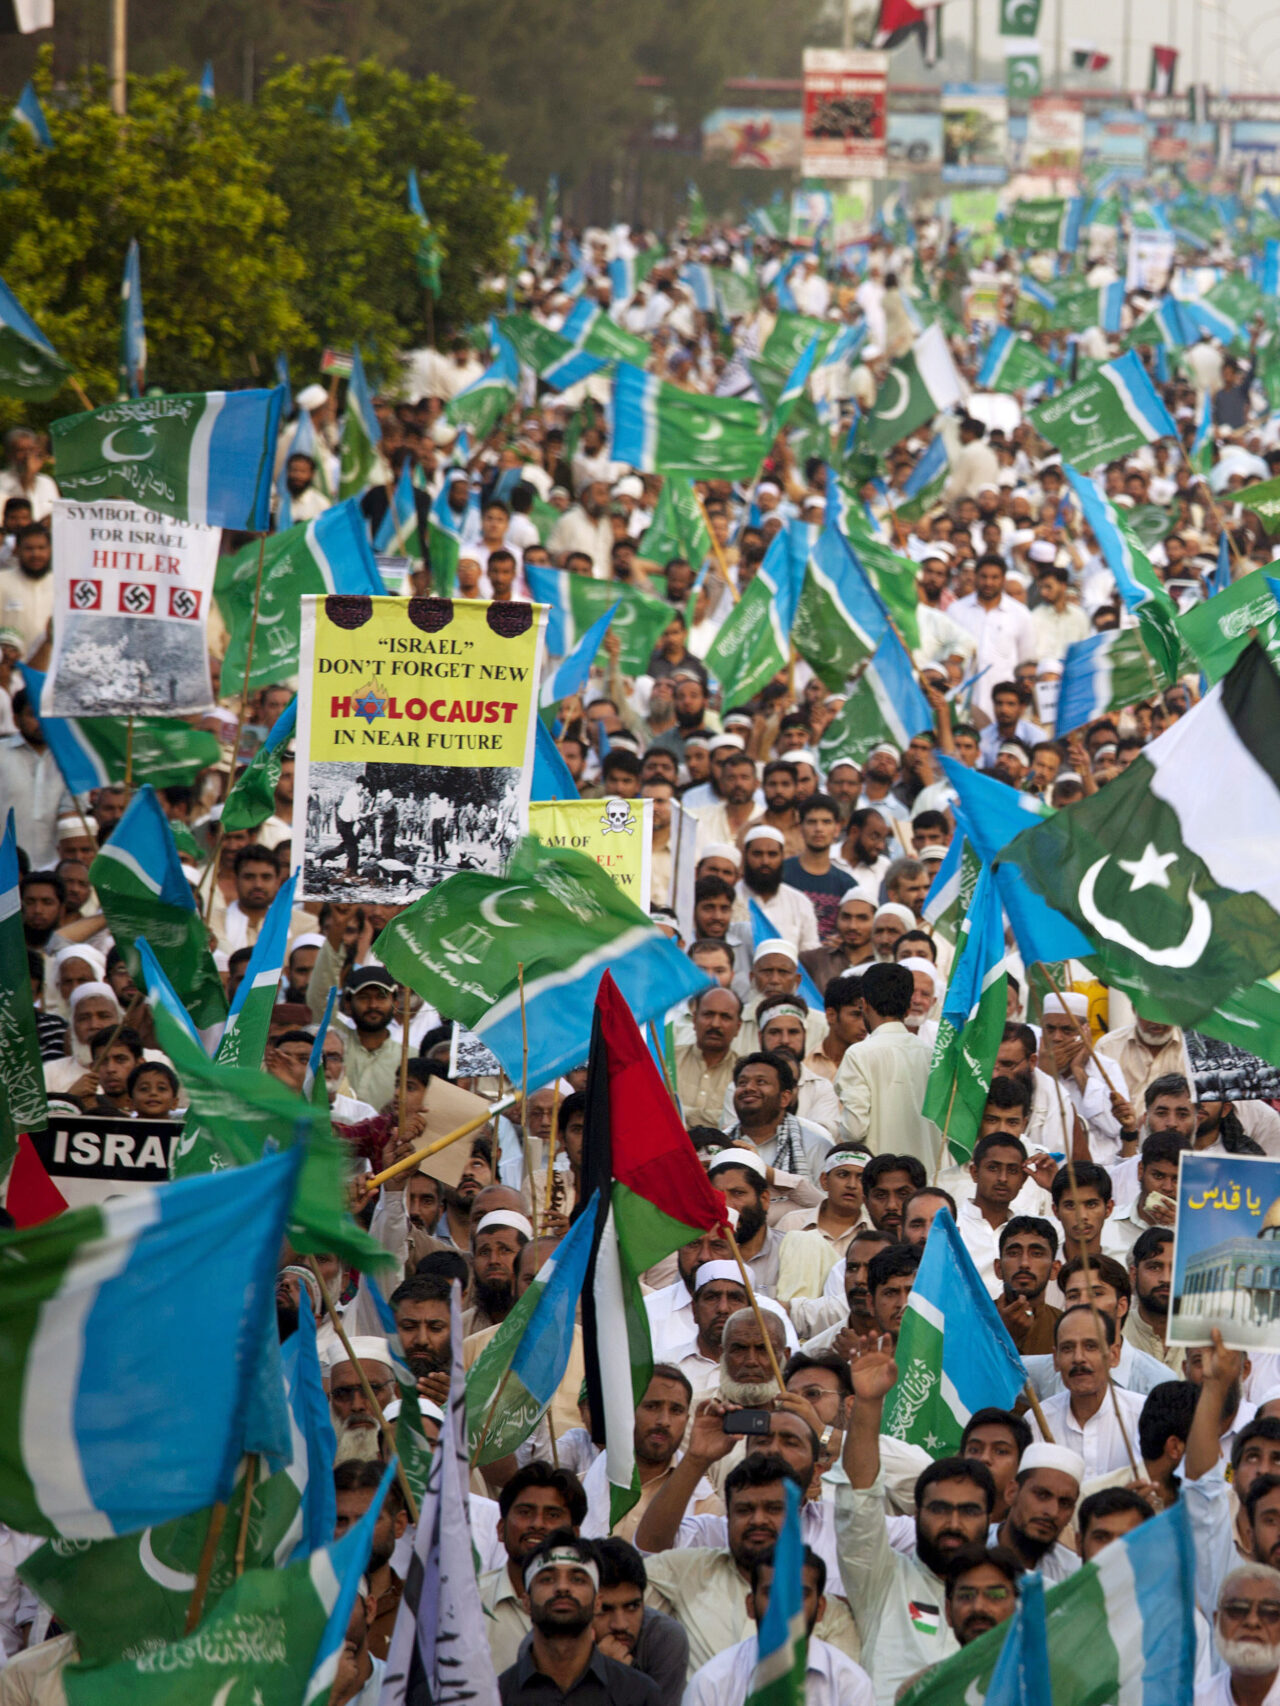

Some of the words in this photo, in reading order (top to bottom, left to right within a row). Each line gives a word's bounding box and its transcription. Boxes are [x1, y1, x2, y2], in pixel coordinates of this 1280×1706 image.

[66, 505, 141, 525] SYMBOL
[90, 528, 123, 543] FOR
[129, 530, 188, 549] ISRAEL
[91, 550, 181, 576] HITLER
[318, 658, 386, 677] DON’T
[391, 660, 476, 679] FORGET
[479, 664, 529, 682] NEW
[333, 729, 355, 745] IN
[361, 730, 420, 748] NEAR
[427, 732, 503, 750] FUTURE
